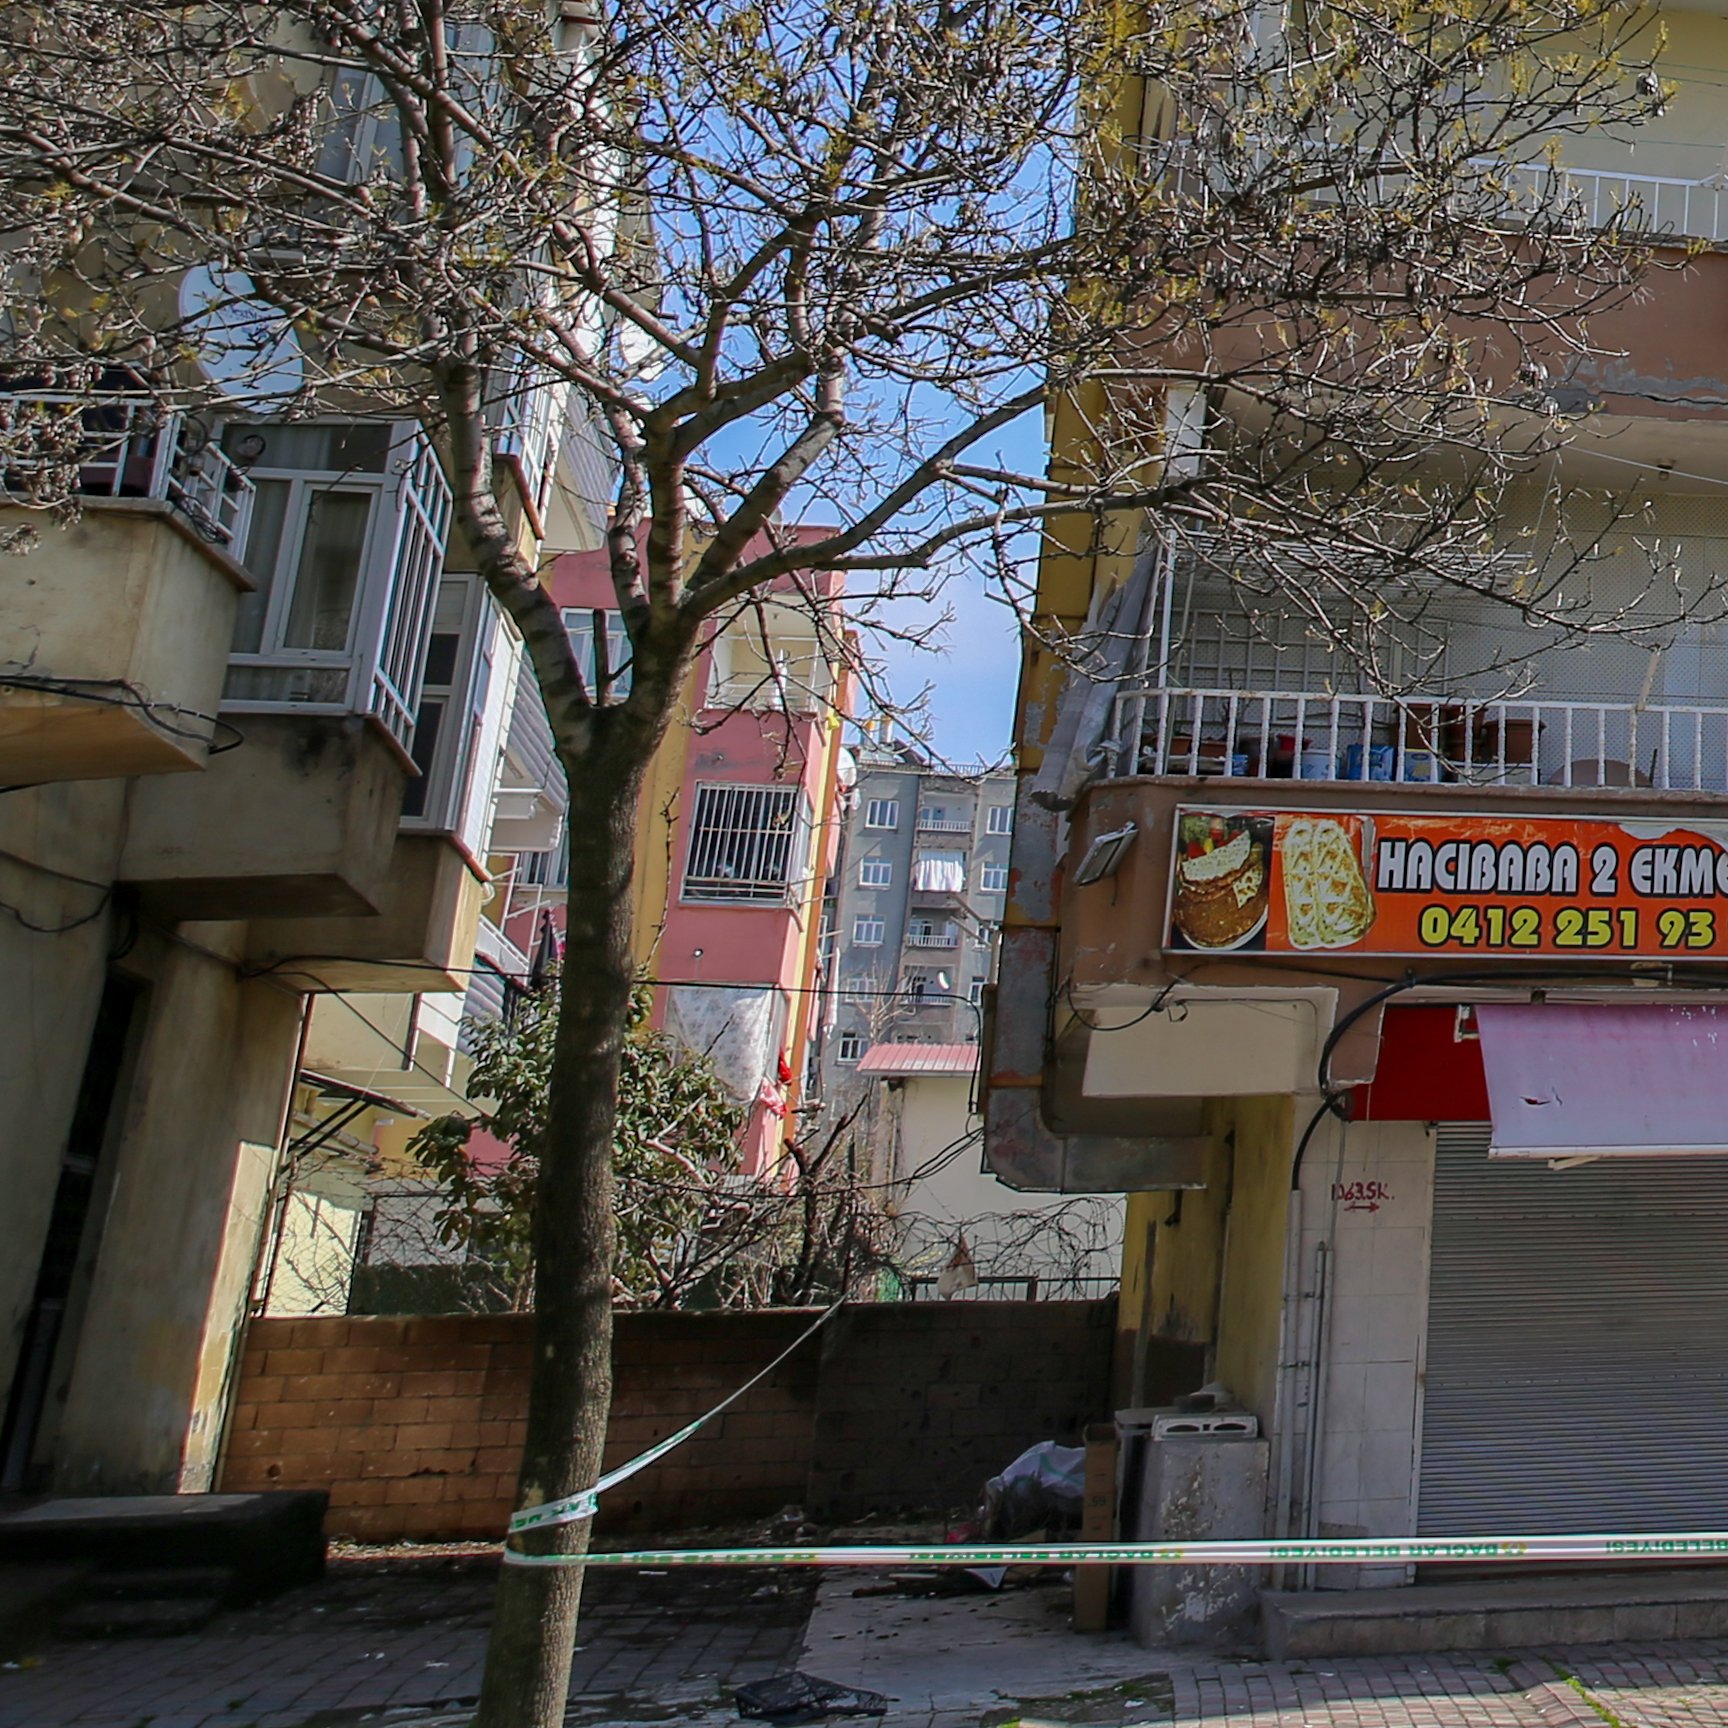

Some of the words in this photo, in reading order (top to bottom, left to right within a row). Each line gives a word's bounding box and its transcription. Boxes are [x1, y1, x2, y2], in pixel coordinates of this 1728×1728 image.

[1376, 839, 1579, 895] HACIBABA
[1590, 850, 1617, 893] 2
[1420, 907, 1542, 948] 0412
[1554, 909, 1638, 949] 251
[1658, 910, 1715, 949] 93
